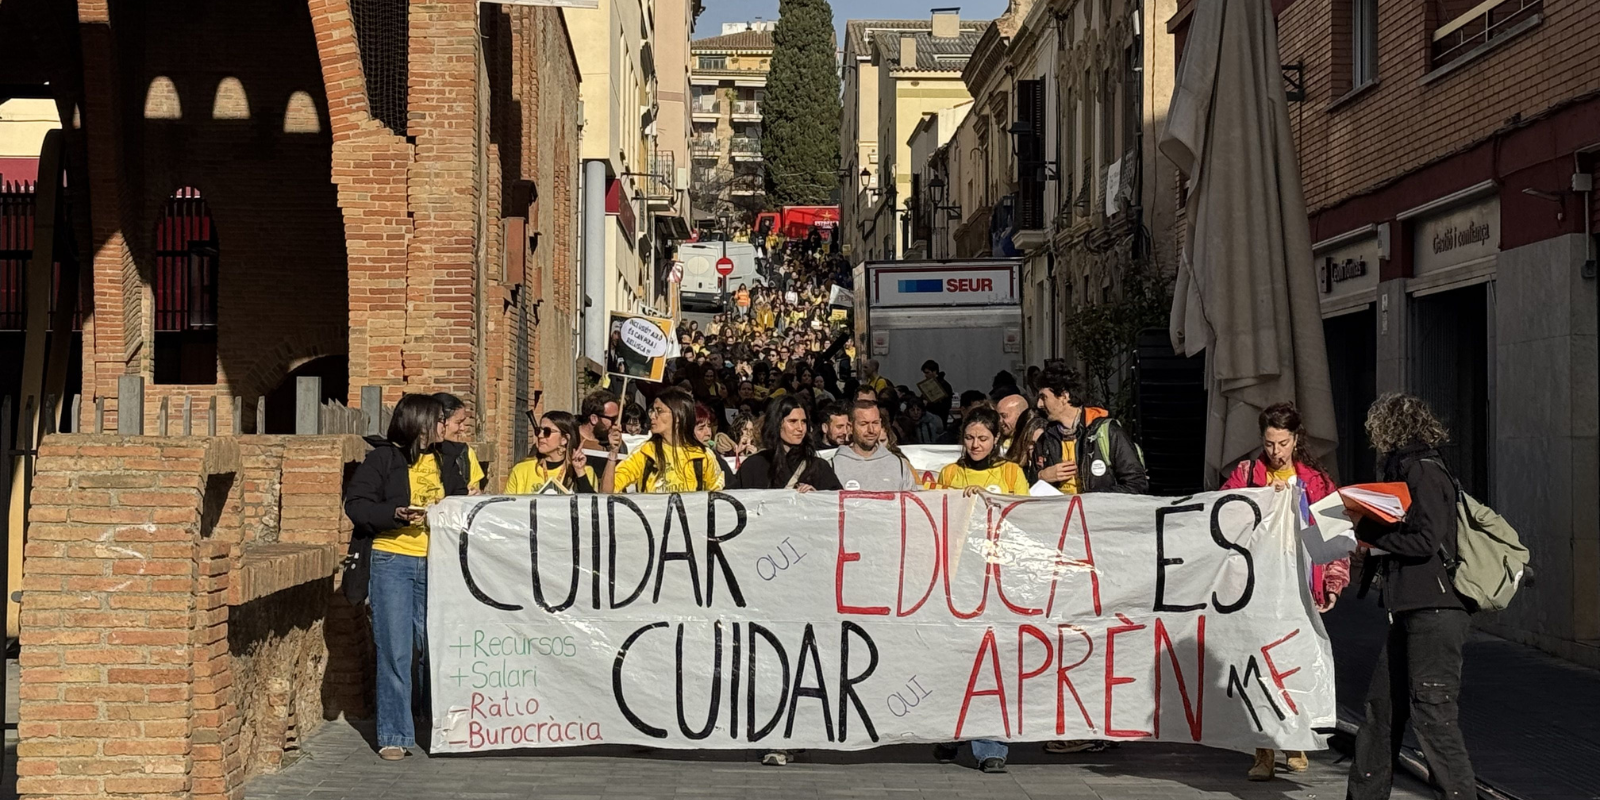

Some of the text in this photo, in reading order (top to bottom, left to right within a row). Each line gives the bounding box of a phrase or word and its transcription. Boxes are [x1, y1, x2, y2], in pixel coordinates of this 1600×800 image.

[946, 278, 993, 293] SEUR
[634, 332, 643, 341] CAN
[458, 490, 1262, 620] CUIDAR QUI EDUCA ÉS
[449, 630, 577, 658] +Recursos
[449, 661, 538, 688] +Salari
[612, 612, 1206, 743] CUIDAR QUI APRÈN
